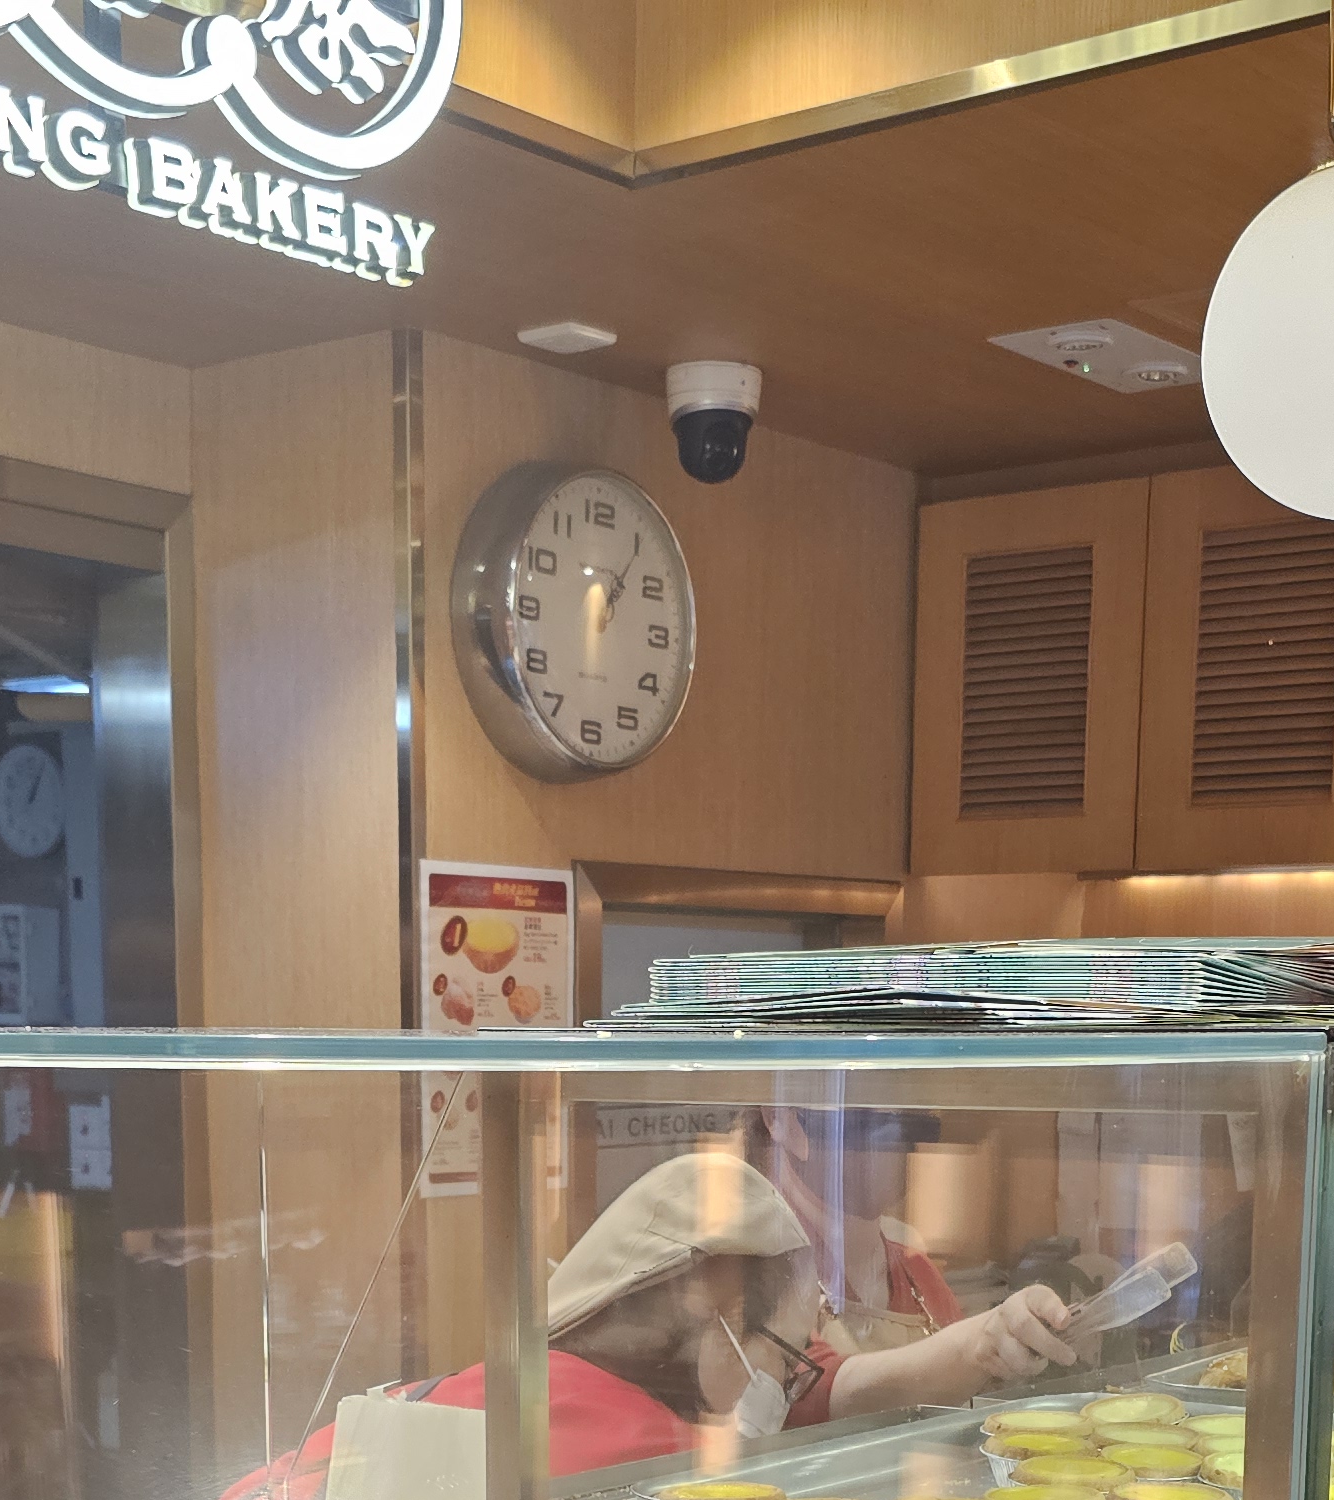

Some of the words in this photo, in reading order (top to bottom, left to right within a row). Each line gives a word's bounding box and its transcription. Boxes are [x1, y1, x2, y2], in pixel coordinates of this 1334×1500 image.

[129, 137, 435, 286] BAKERY
[553, 510, 572, 538] 11
[585, 498, 616, 530] 12
[528, 546, 557, 576] 10
[642, 575, 663, 602] 2
[518, 594, 540, 621] 9
[648, 625, 669, 650] 3
[526, 648, 547, 675] 8
[638, 672, 659, 697] 4
[543, 690, 564, 717] 7
[580, 719, 602, 745] 6
[617, 706, 638, 731] 5
[627, 1112, 716, 1138] CHEONG
